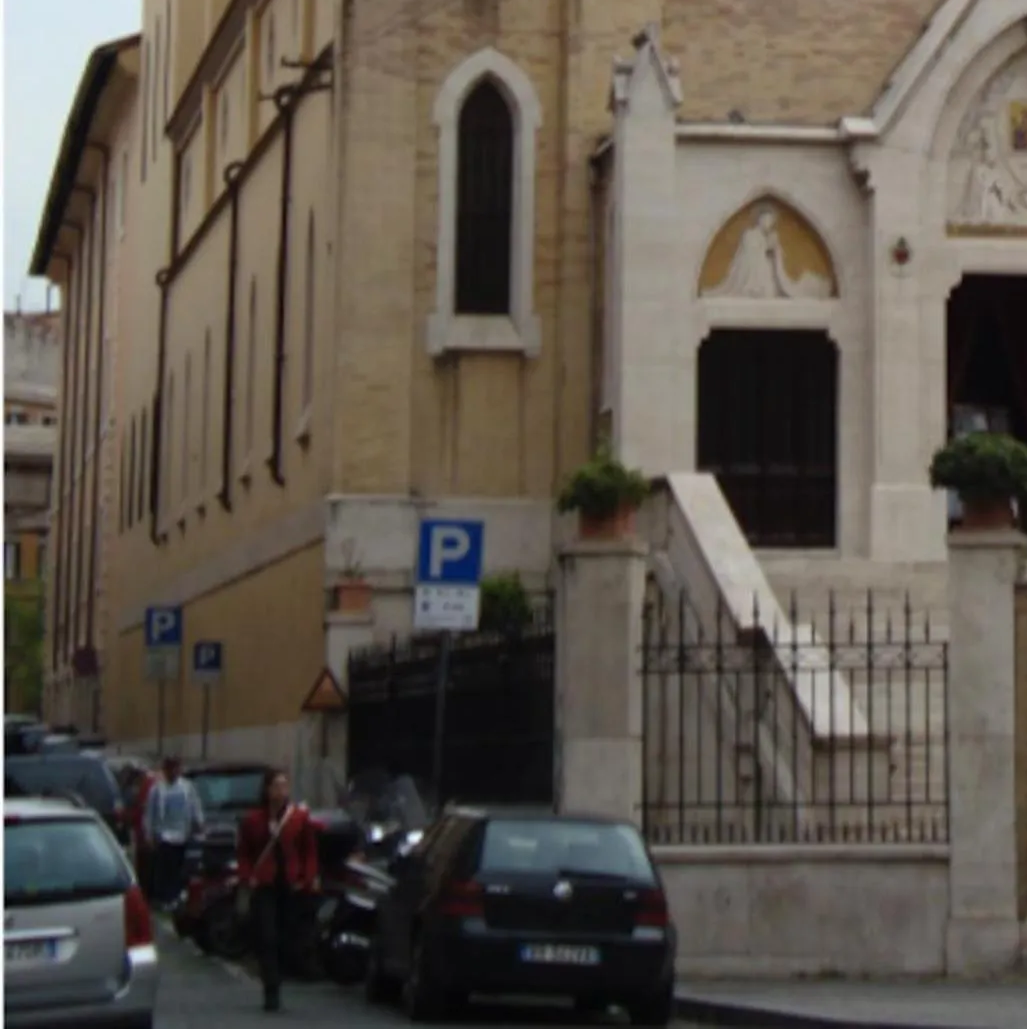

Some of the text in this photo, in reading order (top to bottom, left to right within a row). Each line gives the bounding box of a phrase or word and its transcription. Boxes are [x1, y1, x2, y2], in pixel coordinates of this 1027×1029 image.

[430, 525, 471, 578] P
[151, 610, 176, 641] P
[199, 646, 215, 665] P
